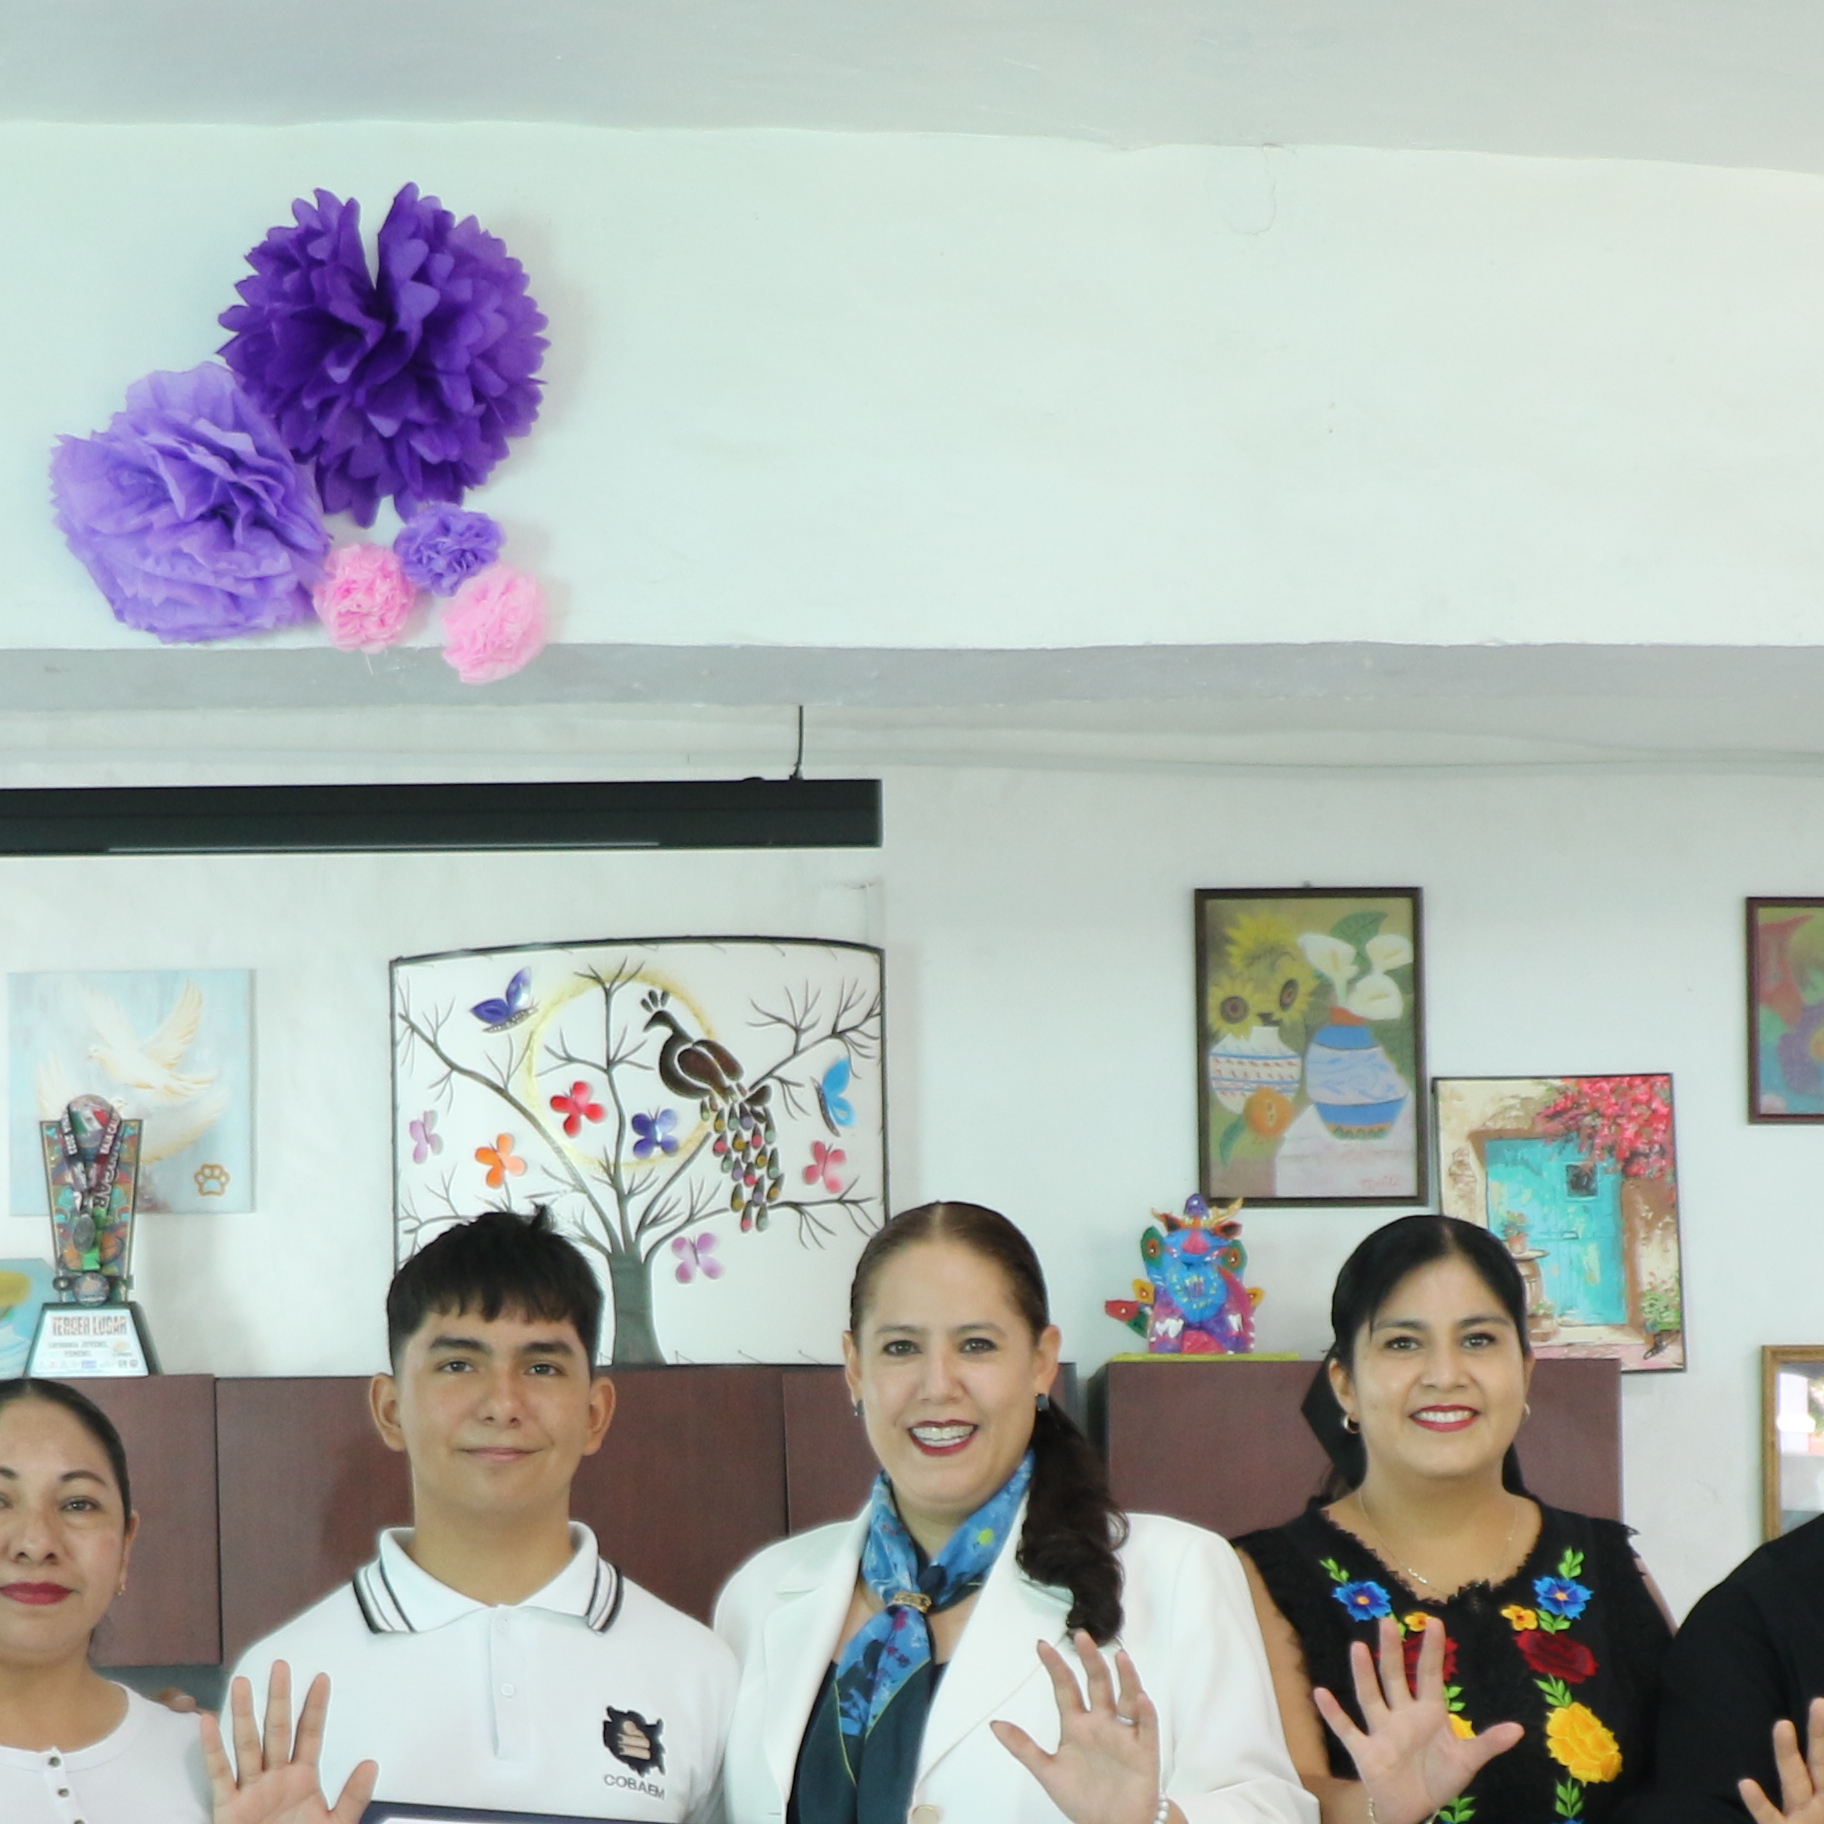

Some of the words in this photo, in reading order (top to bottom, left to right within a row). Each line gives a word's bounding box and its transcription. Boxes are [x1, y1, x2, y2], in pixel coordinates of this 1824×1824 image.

[53, 1315, 90, 1335] TERCER
[92, 1315, 127, 1335] LUGAR
[603, 1774, 665, 1800] COBAEM
